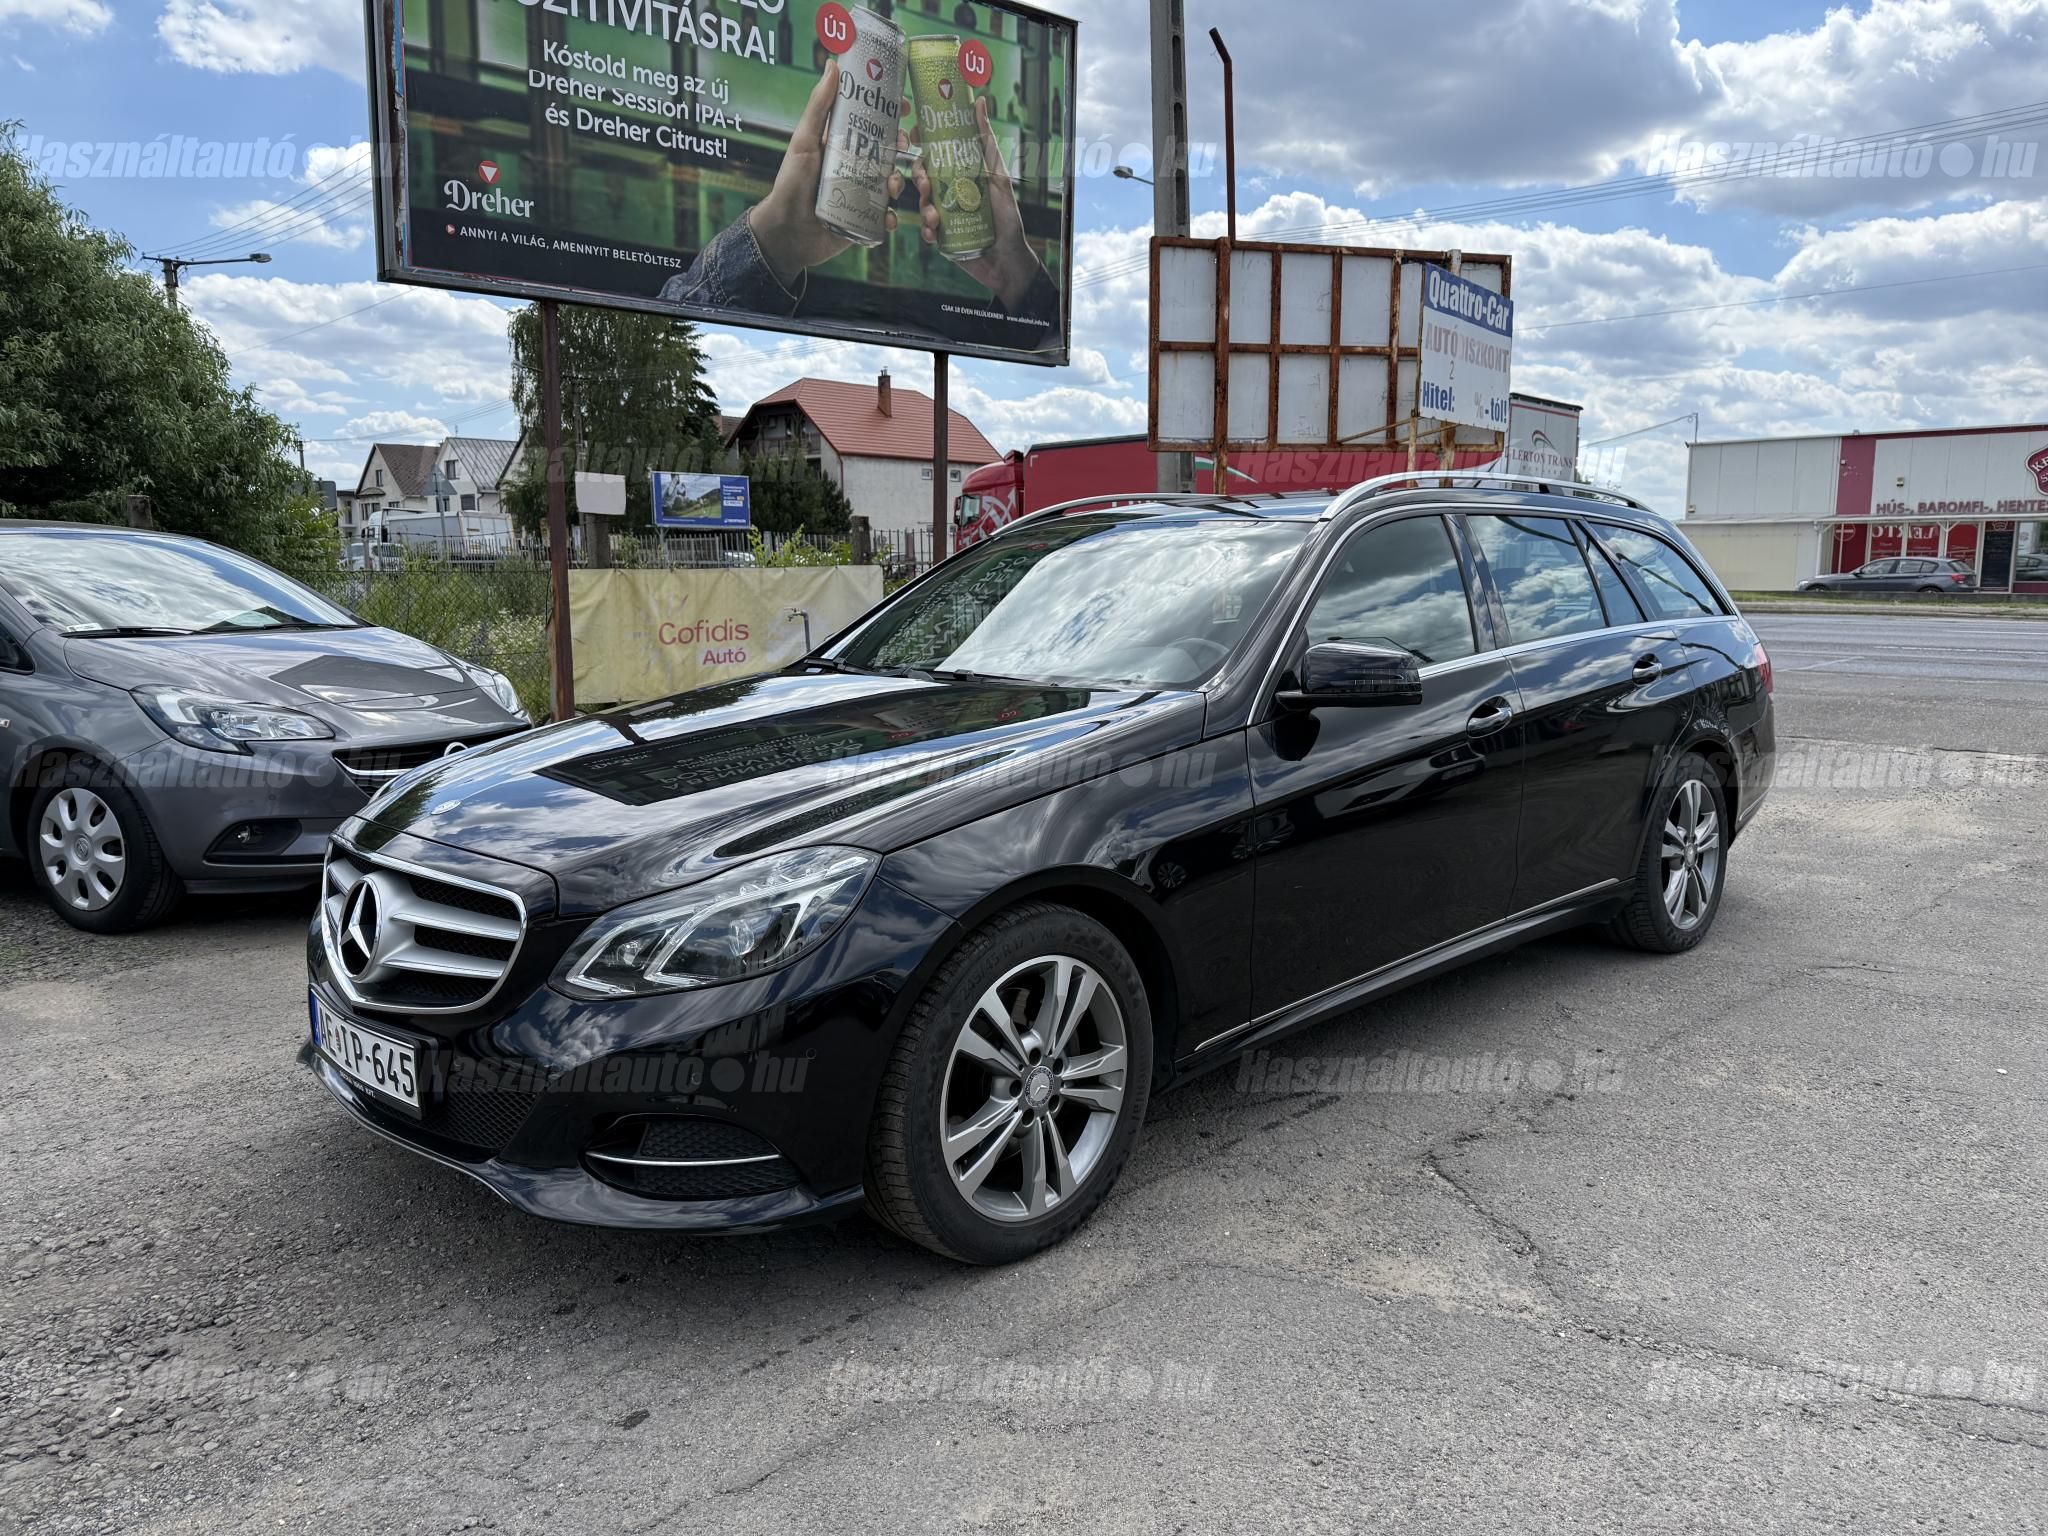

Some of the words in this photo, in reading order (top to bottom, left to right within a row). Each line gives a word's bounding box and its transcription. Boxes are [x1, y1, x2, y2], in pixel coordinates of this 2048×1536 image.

[824, 15, 846, 41] ÚJ
[543, 39, 625, 79] Kóstold
[632, 65, 678, 95] meg
[683, 75, 705, 95] az
[712, 78, 728, 104] új
[965, 50, 985, 75] ÚJ
[612, 88, 688, 120] Session
[695, 102, 742, 132] IPA-t
[849, 112, 885, 140] SESSION
[545, 102, 569, 127] és
[577, 108, 650, 143] Dreher
[656, 125, 727, 159] Citrust!
[929, 137, 983, 169] CITRUS
[443, 179, 535, 218] Dreher
[460, 226, 497, 241] ANNYI
[501, 231, 508, 242] A
[511, 231, 550, 250] VILÁG,
[553, 239, 610, 258] AMENNYIT
[612, 248, 682, 269] BELETÖLTESZ
[1429, 270, 1509, 331] Quattro-Car
[1422, 381, 1455, 413] Hitel:
[1997, 499, 2048, 513] HENTE
[658, 619, 749, 646] Cofidis
[703, 647, 746, 666] Autó
[340, 1025, 415, 1098] IP-645
